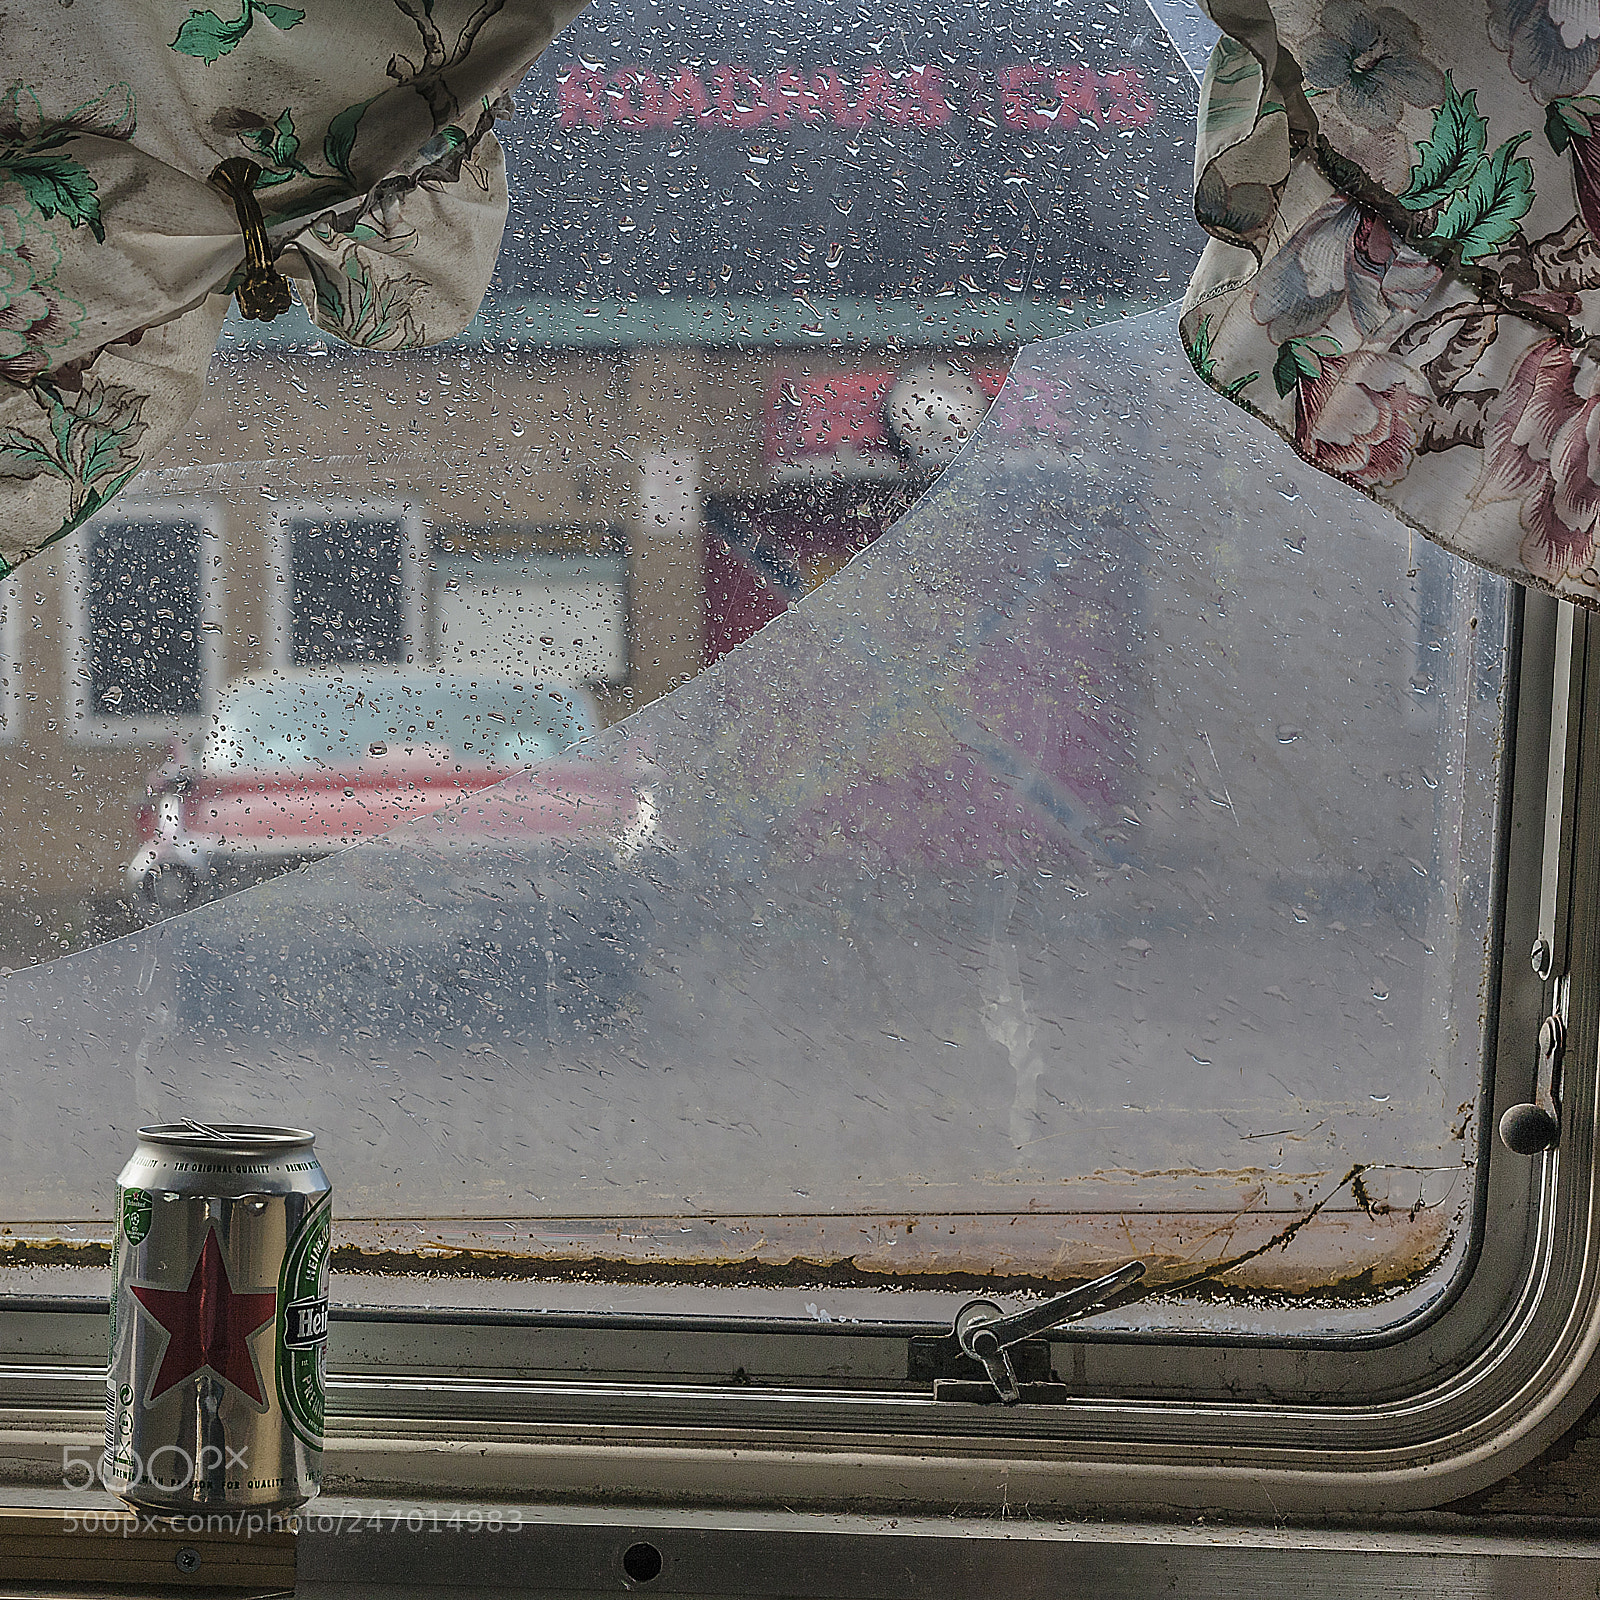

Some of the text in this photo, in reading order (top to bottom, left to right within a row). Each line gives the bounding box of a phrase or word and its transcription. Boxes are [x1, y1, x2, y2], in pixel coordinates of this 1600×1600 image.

[174, 1162, 189, 1171] THE
[192, 1163, 232, 1173] ORIGINAL
[236, 1164, 270, 1174] QUALITY
[222, 1480, 240, 1490] FOR
[247, 1477, 285, 1490] QUALITY
